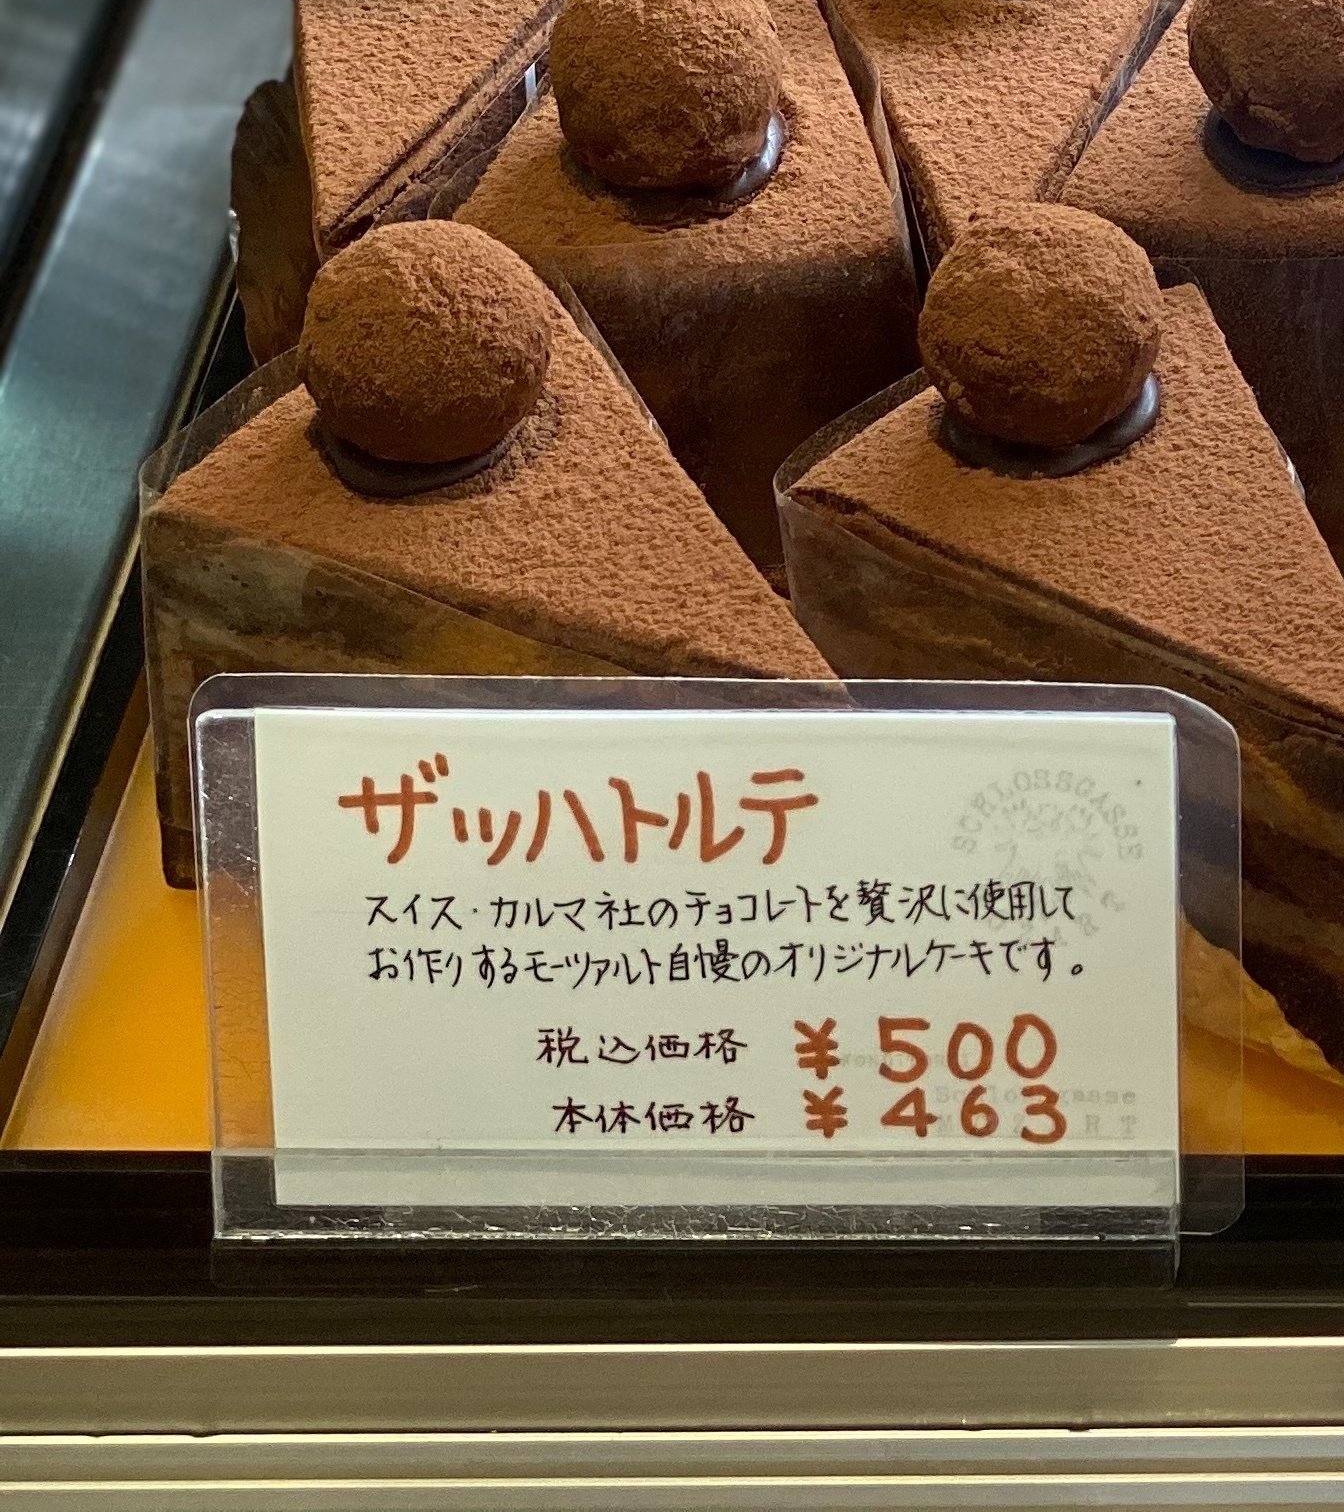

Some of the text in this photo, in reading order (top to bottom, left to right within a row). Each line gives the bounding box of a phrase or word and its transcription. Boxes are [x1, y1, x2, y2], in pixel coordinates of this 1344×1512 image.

[338, 754, 819, 866] ザッハトルテ
[368, 937, 1083, 989] お作りするモーツァルト自慢のオリジナルケーキです。
[536, 1013, 1058, 1083] 税込価格 ¥500
[552, 1085, 1068, 1145] 本体価格 ¥463
